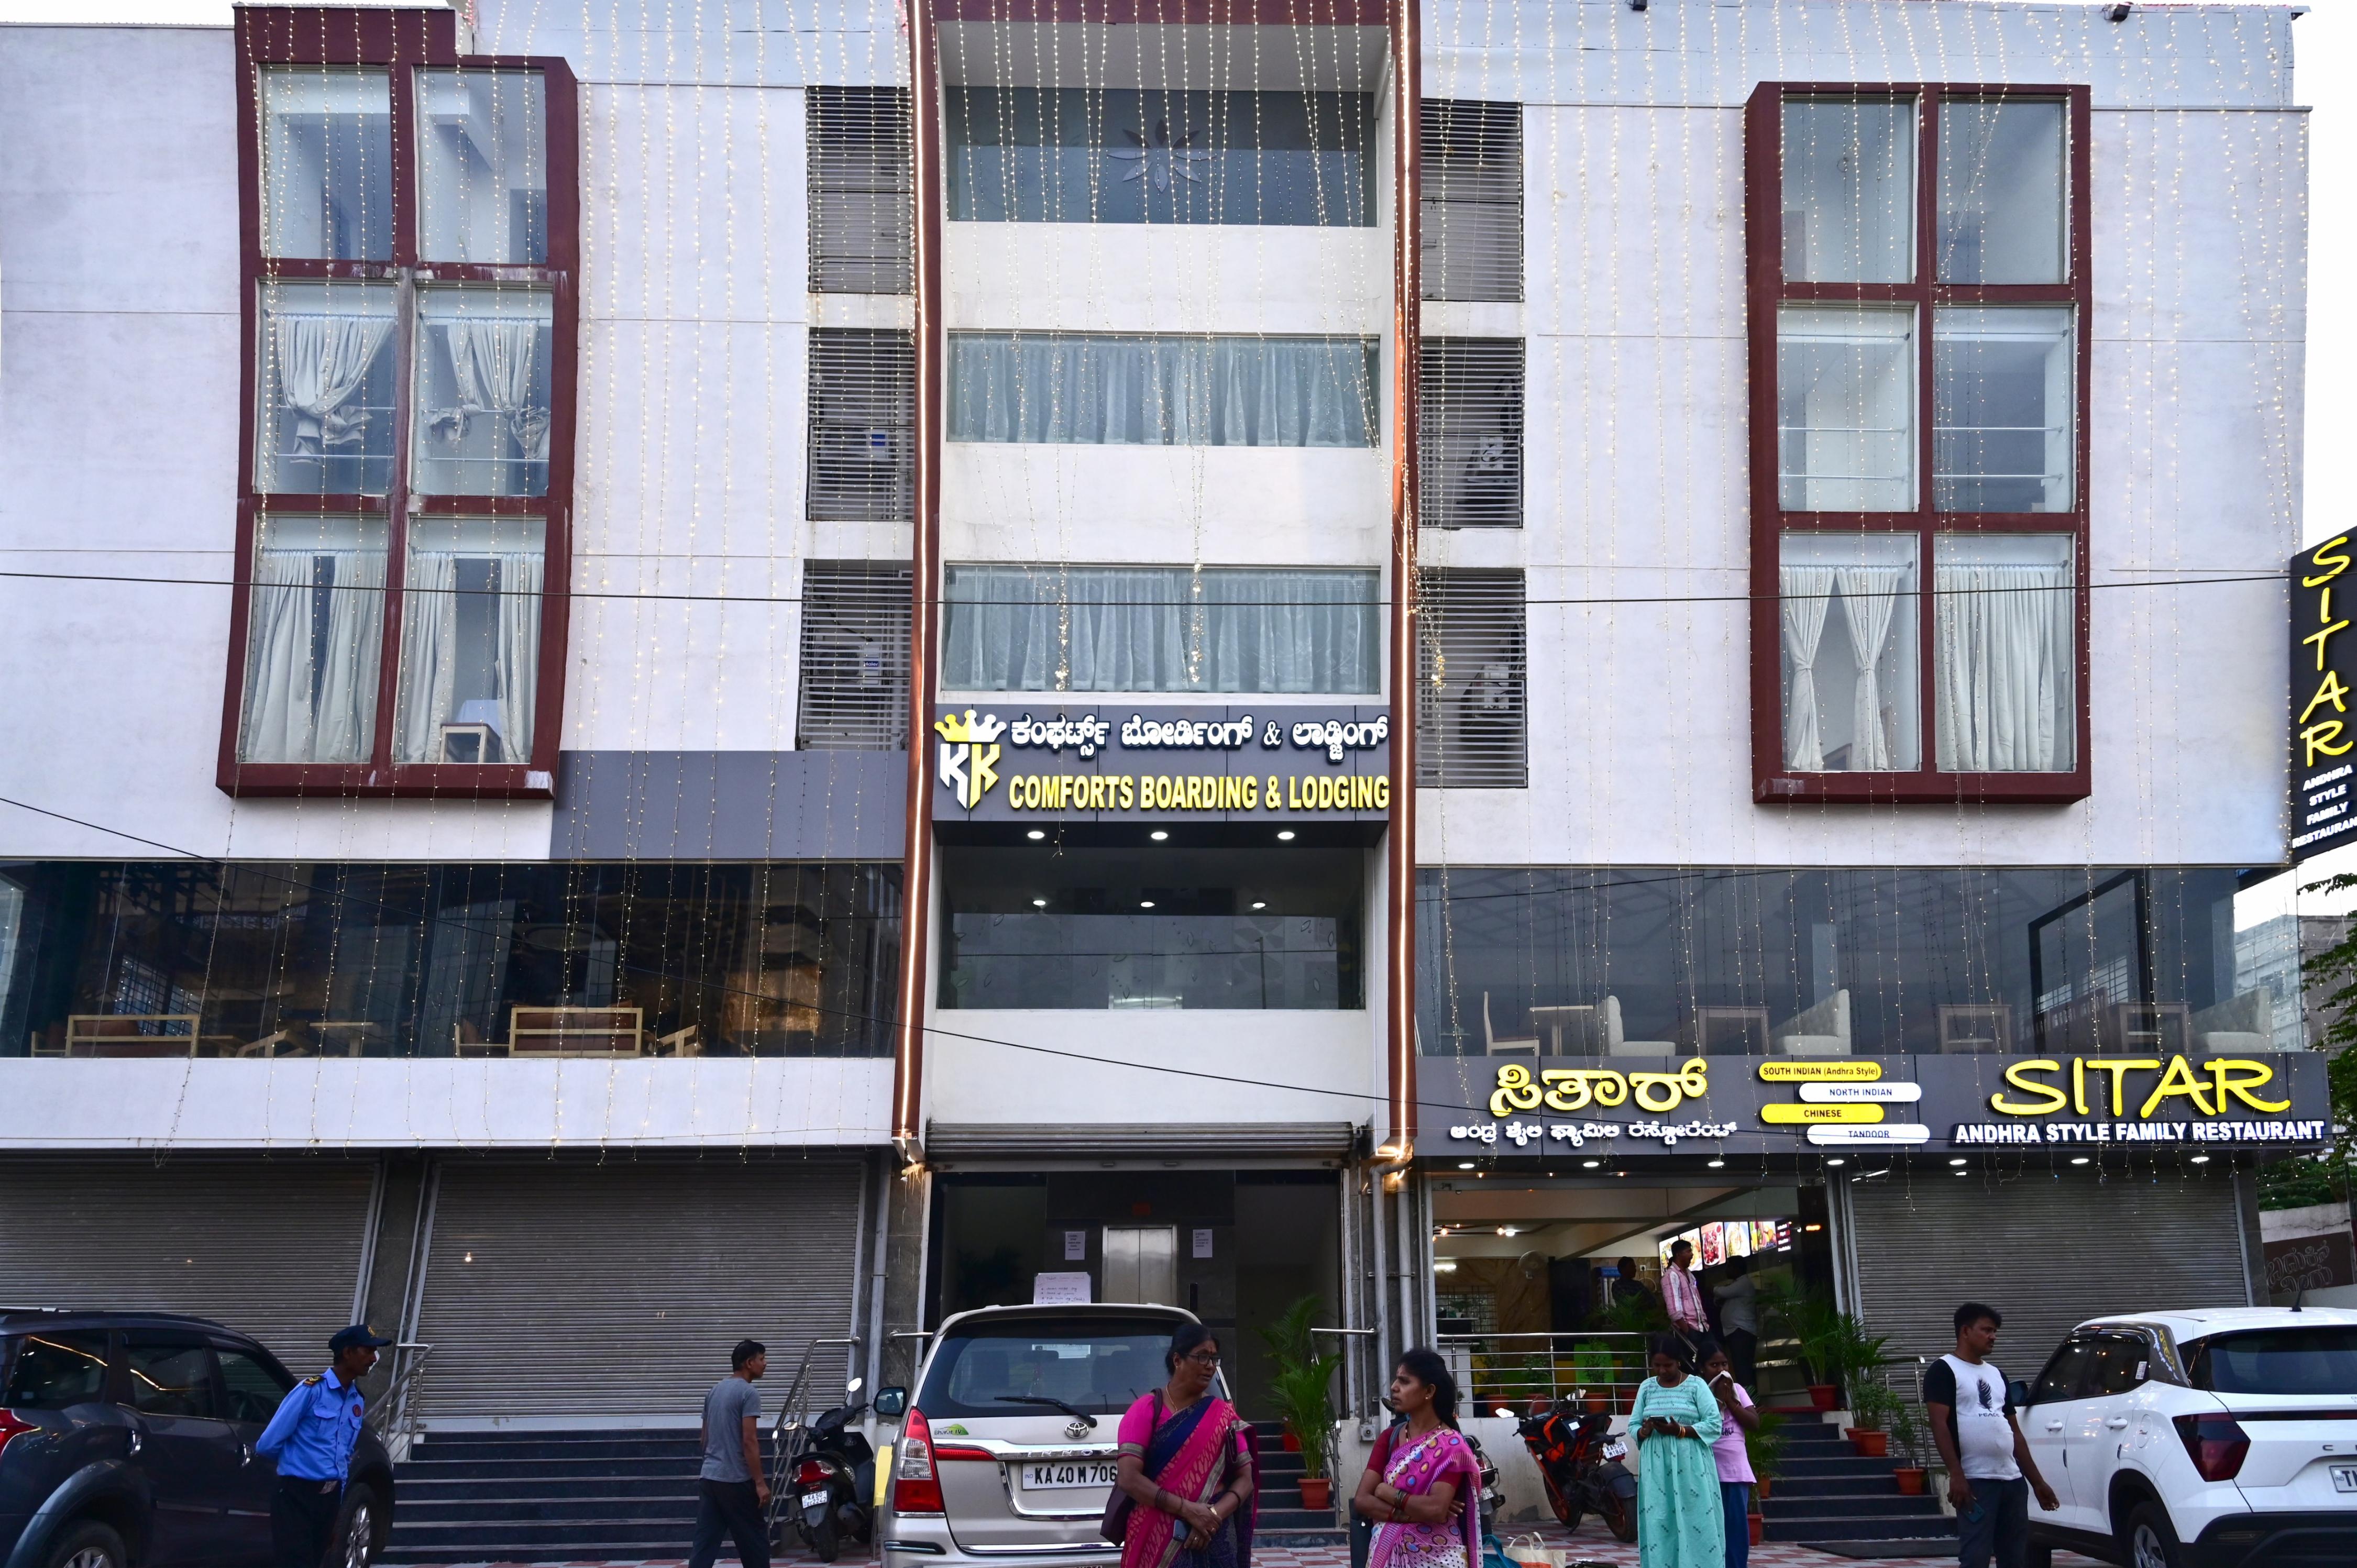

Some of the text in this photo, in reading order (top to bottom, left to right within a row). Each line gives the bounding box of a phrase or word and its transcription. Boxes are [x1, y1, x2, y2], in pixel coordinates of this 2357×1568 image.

[2300, 536, 2353, 767] SITAR
[1121, 715, 1252, 745] ಬೋರ್ಡಿಂಗ್
[1263, 721, 1281, 745] &
[1293, 716, 1387, 760] ಲಾಡ್ಜಿಂಗ್
[2303, 764, 2353, 791] ANDHRA
[1010, 775, 1390, 809] COMFORTS BOARDING & LODGING
[2309, 783, 2347, 806] STYLE
[2307, 801, 2349, 825] FAMILY
[2292, 816, 2357, 848] RESTAURAN
[1824, 1067, 1854, 1076] (Andhra
[1856, 1067, 1878, 1076] Style)
[1490, 1057, 1708, 1117] ಸಿತಾರ್
[1991, 1055, 2290, 1118] SITAR
[1955, 1121, 2324, 1143] ANDHRA STYLE FAMILY RESTAURANT
[1027, 1448, 1114, 1457] INNOV
[1035, 1466, 1117, 1484] KA 40 M 706
